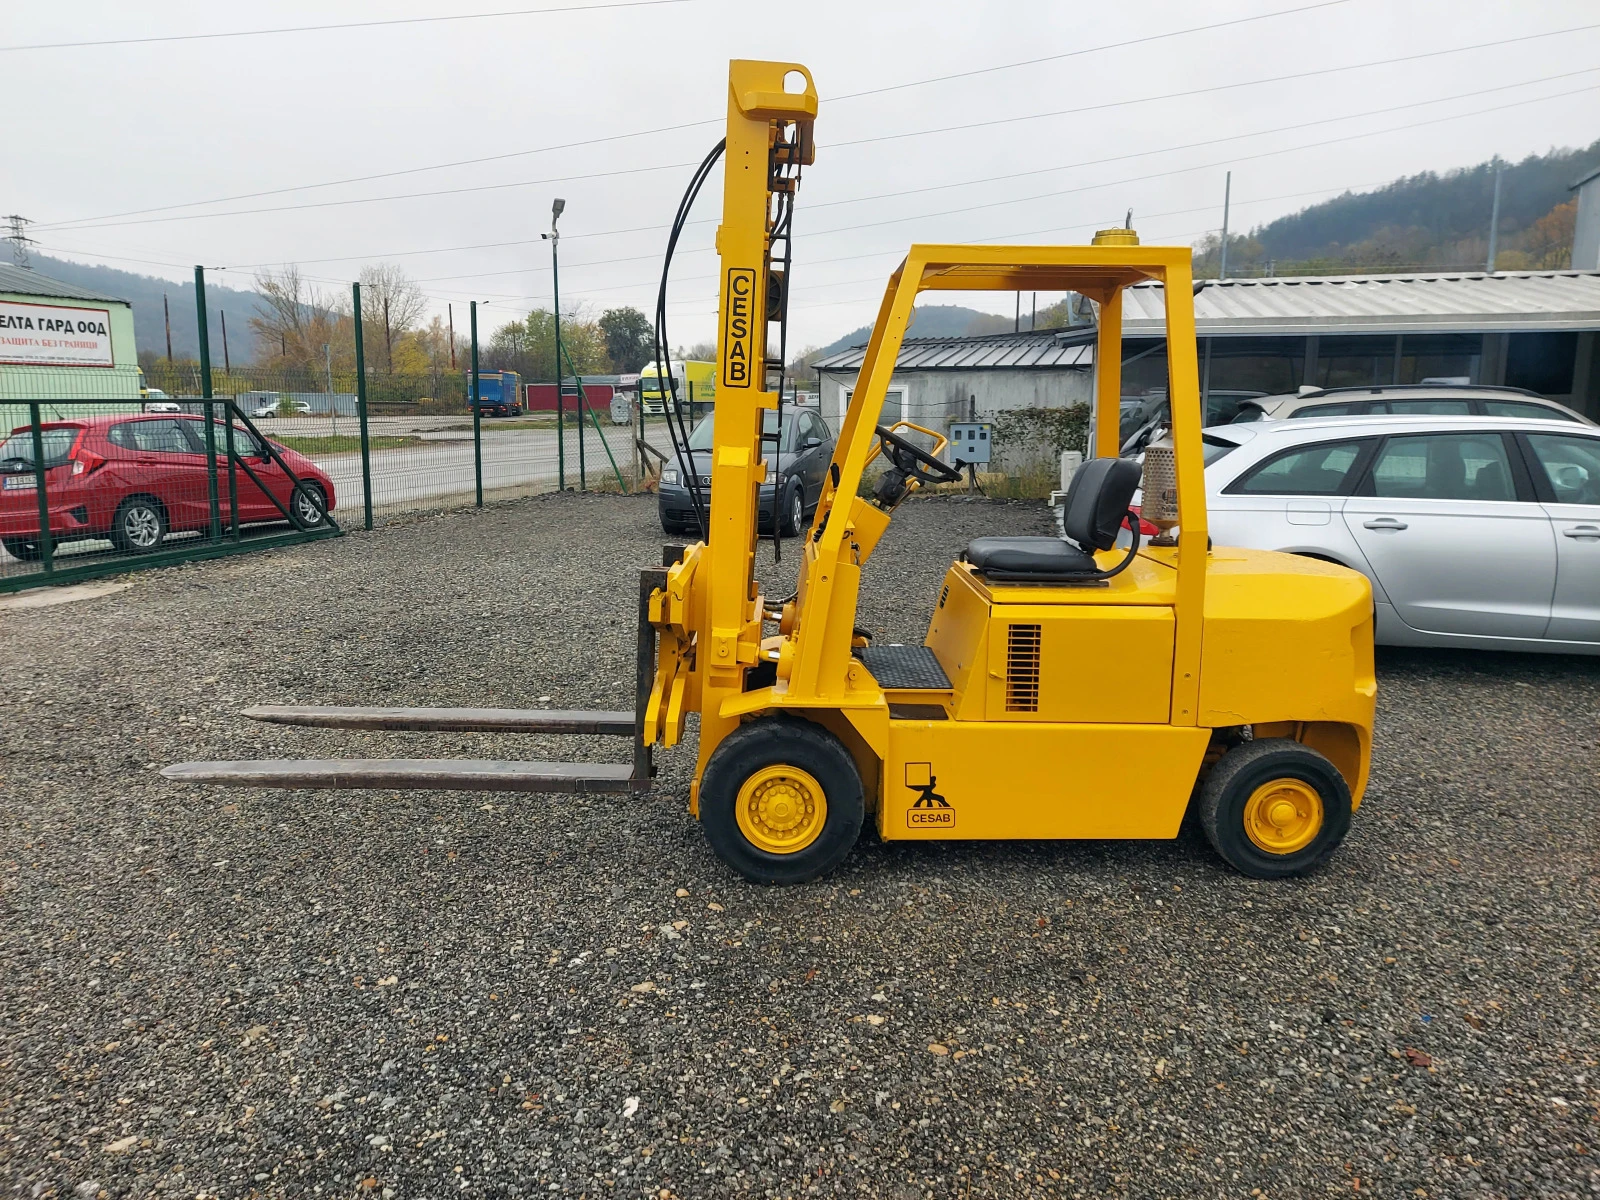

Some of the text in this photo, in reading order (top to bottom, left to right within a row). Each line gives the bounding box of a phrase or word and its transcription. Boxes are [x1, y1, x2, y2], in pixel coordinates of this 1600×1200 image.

[38, 317, 75, 335] ГАРД
[77, 320, 107, 337] ООД
[729, 275, 750, 381] CESAB
[0, 336, 98, 350] ЗАЩИТА БЕЗ ГРАНИЦИ
[911, 813, 951, 823] CESAB
